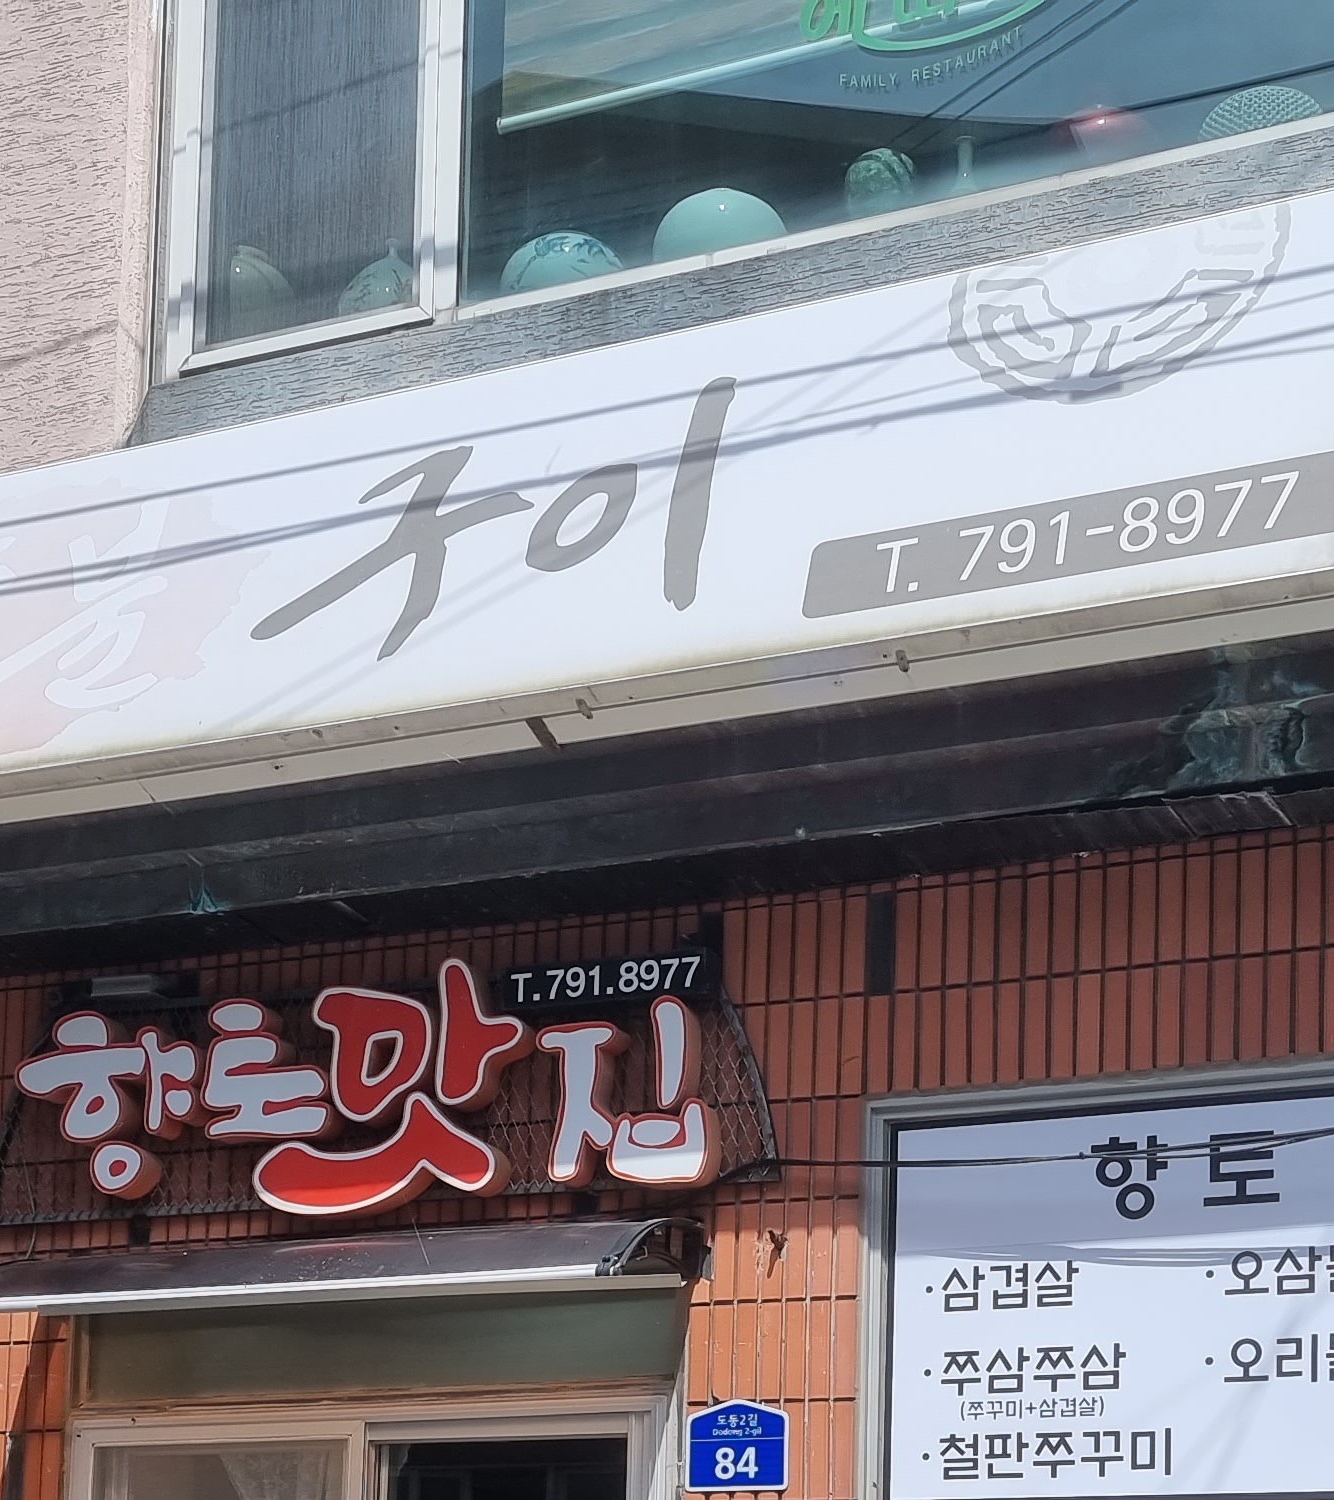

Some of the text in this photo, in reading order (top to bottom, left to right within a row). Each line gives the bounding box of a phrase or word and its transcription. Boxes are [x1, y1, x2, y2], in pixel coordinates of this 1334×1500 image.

[839, 25, 1023, 88] FAMILY RESTAURANT
[250, 375, 738, 662] 구이
[876, 470, 1302, 595] T. 791-8977
[16, 958, 719, 1215] 향토맛집
[1090, 1130, 1281, 1219] 향토
[941, 1260, 1079, 1312] 삼겹살
[940, 1342, 1127, 1395] 쭈삼쭈삼
[714, 1446, 759, 1480] 84
[939, 1427, 1173, 1480] 철판쭈꾸미
